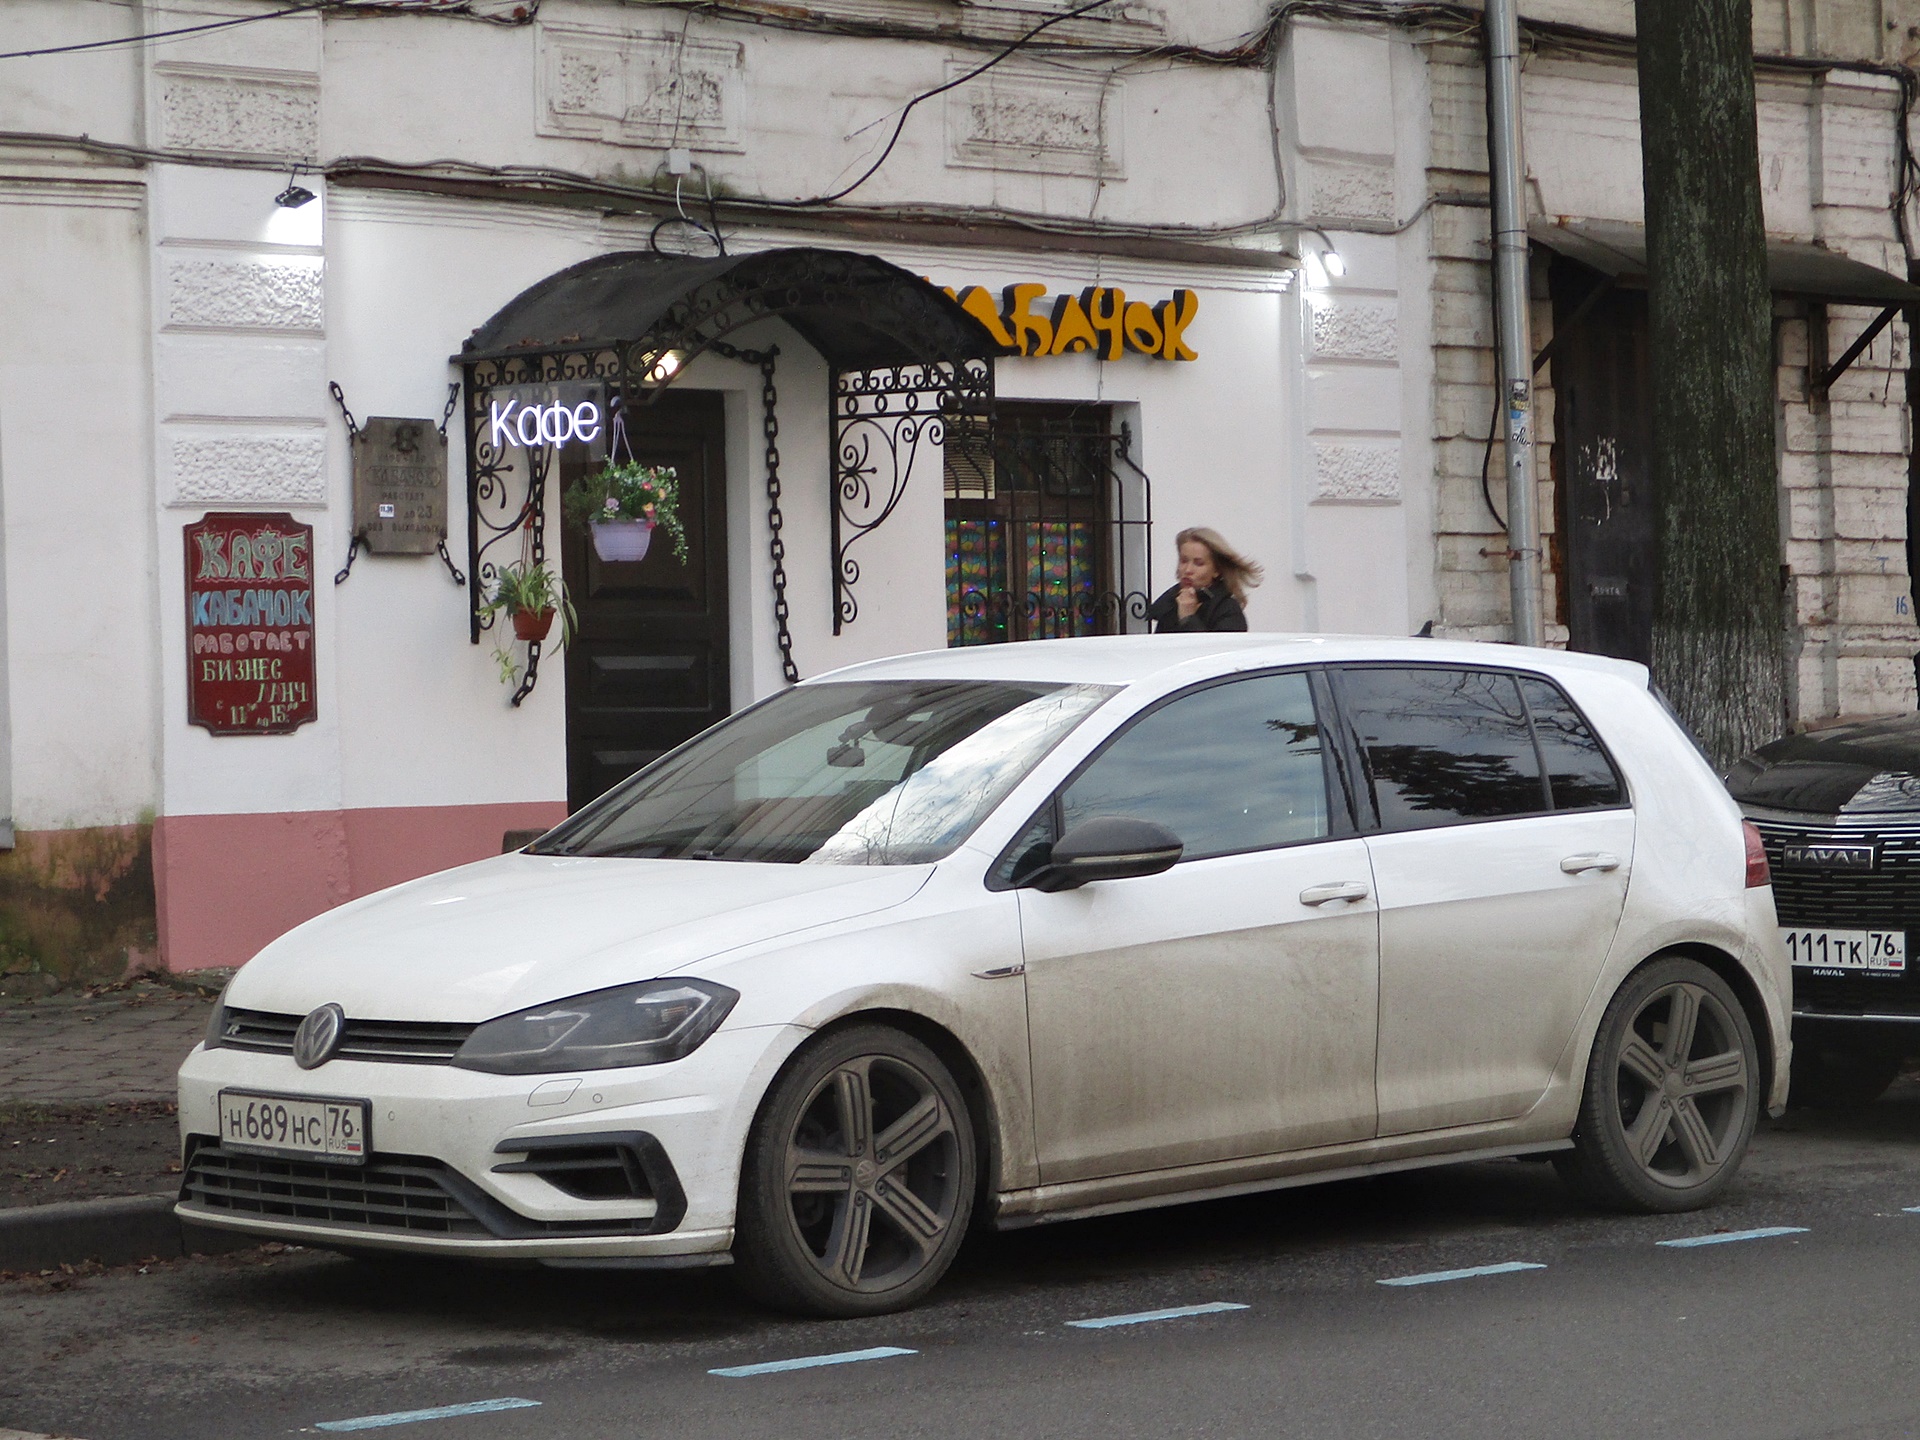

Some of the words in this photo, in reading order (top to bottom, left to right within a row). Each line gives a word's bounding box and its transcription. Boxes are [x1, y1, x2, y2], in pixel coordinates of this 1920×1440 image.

[922, 276, 1198, 362] АБАЧОК
[491, 399, 601, 449] Кафе
[194, 525, 309, 583] КАФЕ
[192, 589, 311, 627] КАБАЧОК
[193, 631, 310, 655] РАБОТАЕТ
[201, 657, 283, 682] БИЗНЕС
[1786, 849, 1867, 865] HAVAL
[1870, 933, 1896, 957] 76
[1812, 968, 1846, 977] HAVAL
[1869, 956, 1888, 967] RUS
[328, 1107, 354, 1138] 76
[328, 1138, 347, 1150] RUS
